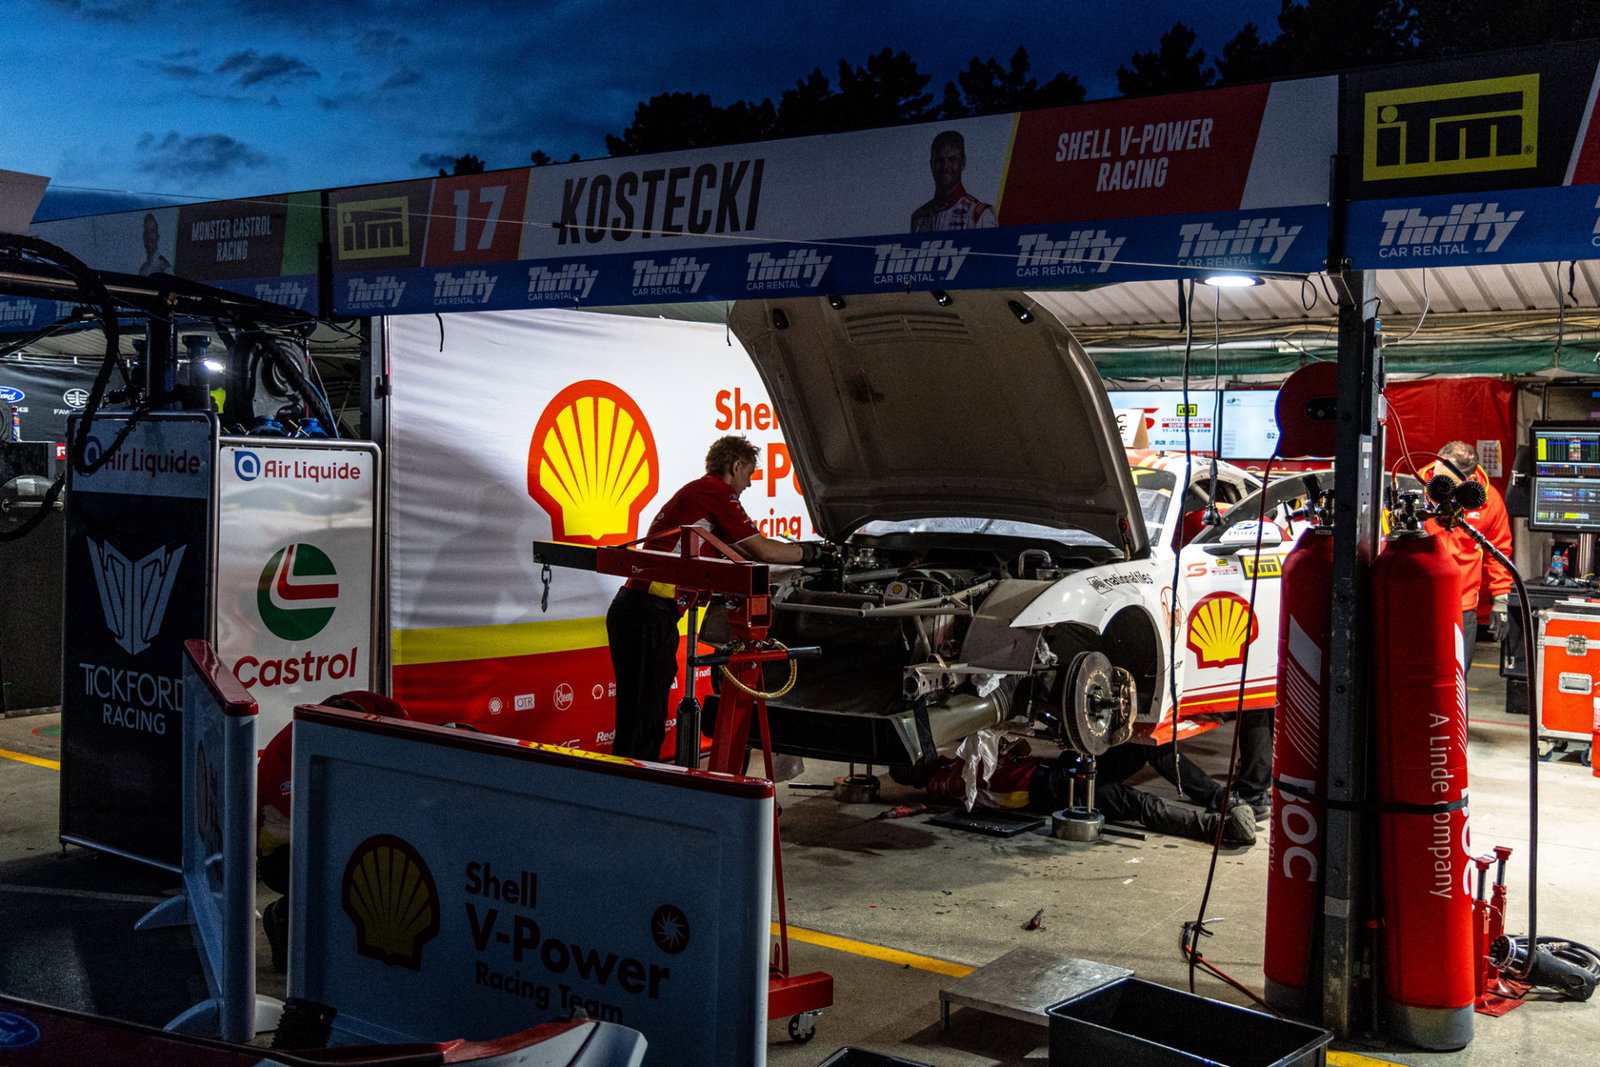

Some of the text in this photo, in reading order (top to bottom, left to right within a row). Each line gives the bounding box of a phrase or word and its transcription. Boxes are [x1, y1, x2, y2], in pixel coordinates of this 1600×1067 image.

[1055, 117, 1214, 163] SHELL V-POWER
[1096, 156, 1169, 192] RACING
[453, 185, 507, 252] 17
[557, 158, 765, 246] KOSTECKI
[191, 215, 272, 242] MONSTER CASTROL
[1177, 217, 1304, 264] Thrifty
[1378, 202, 1525, 253] Thrifty
[216, 240, 248, 263] RACING
[746, 248, 833, 288] Thrifty
[873, 239, 972, 281] Thrifty
[1016, 229, 1127, 273] Thrifty
[1177, 256, 1255, 268] CAR RENTAL
[1378, 244, 1470, 259] CAR RENTAL
[433, 269, 499, 304] Thrifty
[528, 263, 599, 299] Thrifty
[631, 256, 711, 293] Thrifty
[746, 279, 801, 291] CAR RENTAL
[873, 272, 935, 285] CAR RENTAL
[1016, 265, 1085, 278] CAR RENTAL
[255, 281, 308, 310] Thrifty
[347, 275, 407, 308] Thrifty
[347, 301, 385, 310] CAR RENTAL
[433, 296, 475, 306] CAR RENTAL
[528, 291, 575, 302] CAR RENTAL
[631, 285, 682, 297] CAR RENTAL
[0, 299, 38, 326] hrifty
[131, 448, 201, 478] Liquide
[264, 460, 361, 483] Air Liquide
[233, 647, 358, 690] Castrol
[102, 702, 166, 736] RACING
[1427, 713, 1455, 899] A Linde ompany
[1279, 773, 1319, 882] BOC
[465, 861, 537, 909] Shell
[465, 902, 670, 1000] V-Power
[475, 960, 624, 1024] Racing Team
